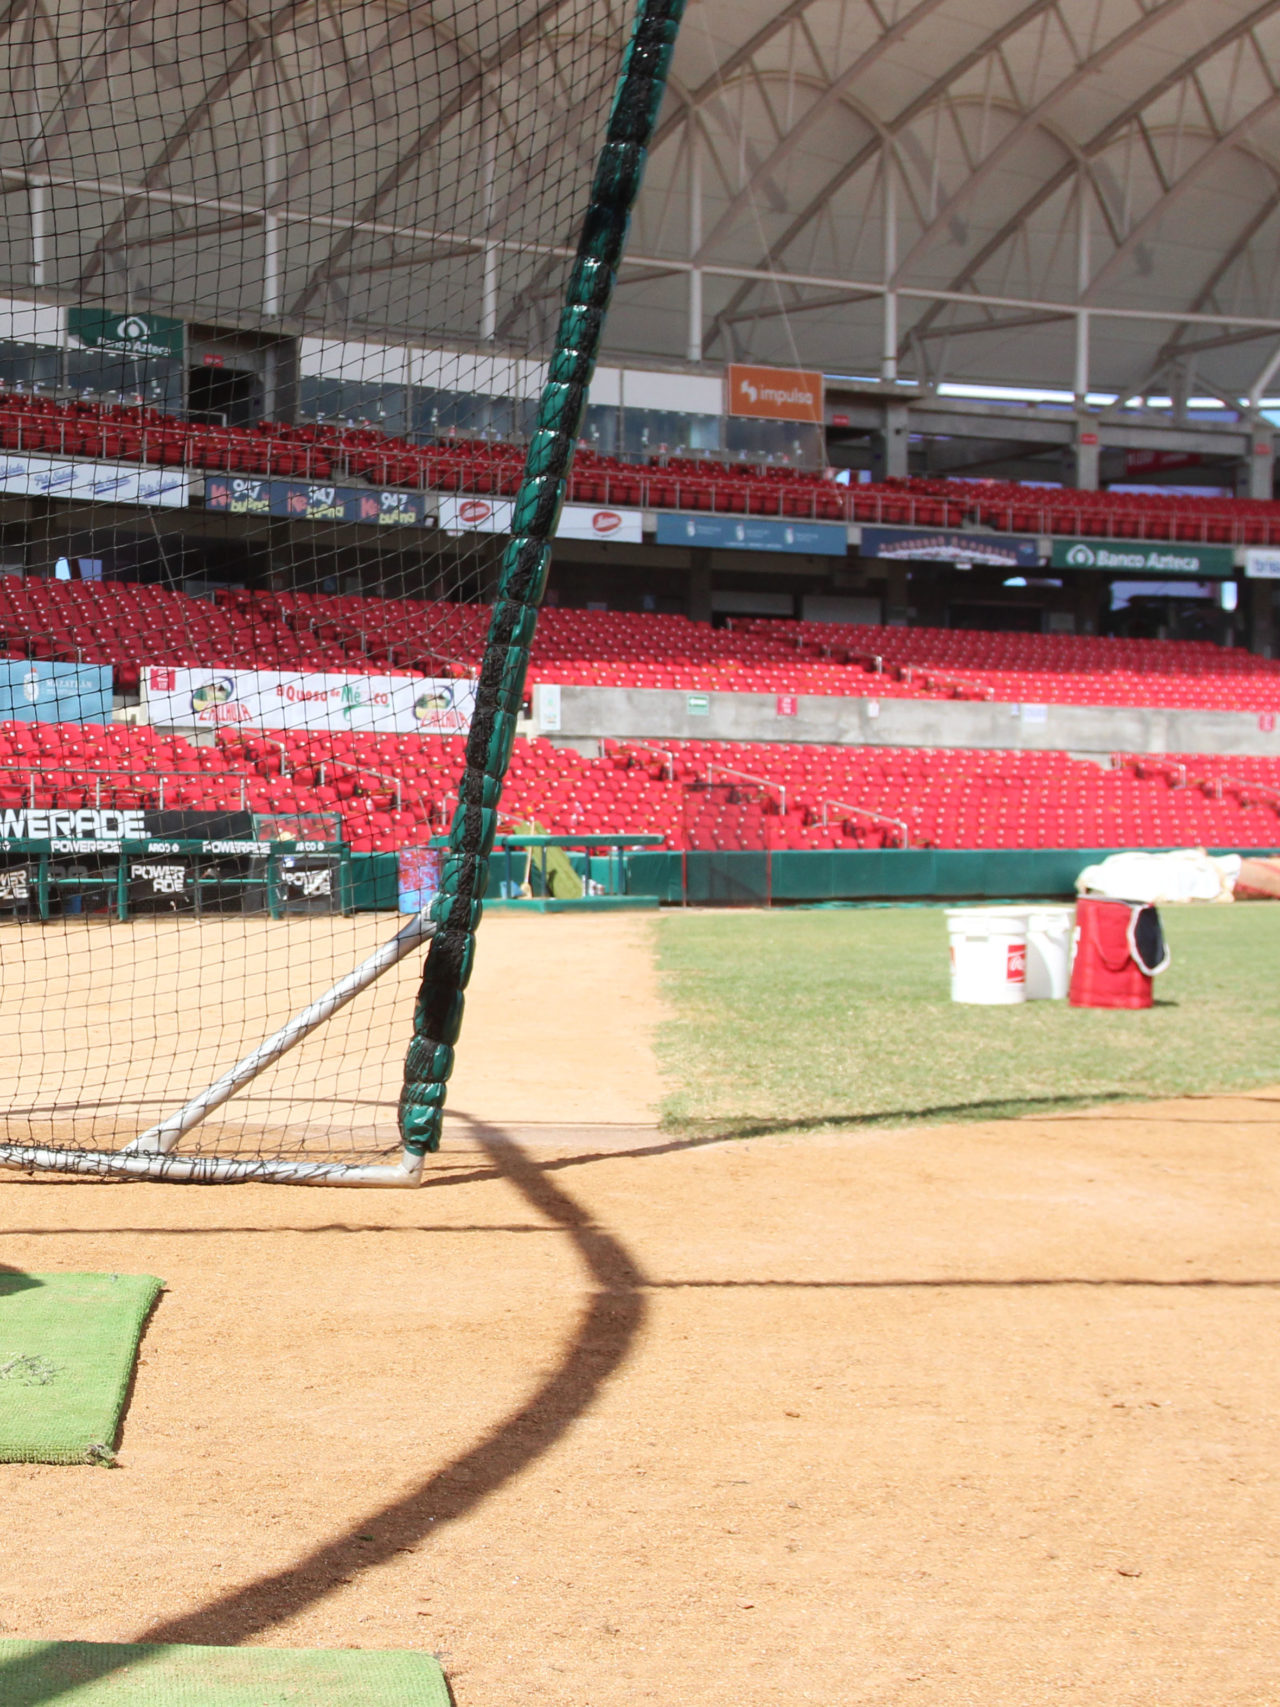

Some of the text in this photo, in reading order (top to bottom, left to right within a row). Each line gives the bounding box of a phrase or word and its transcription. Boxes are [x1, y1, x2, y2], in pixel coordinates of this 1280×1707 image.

[1096, 550, 1200, 571] Banco Azteca
[341, 685, 389, 705] Méco
[131, 865, 186, 879] POWER
[152, 879, 185, 893] ADE
